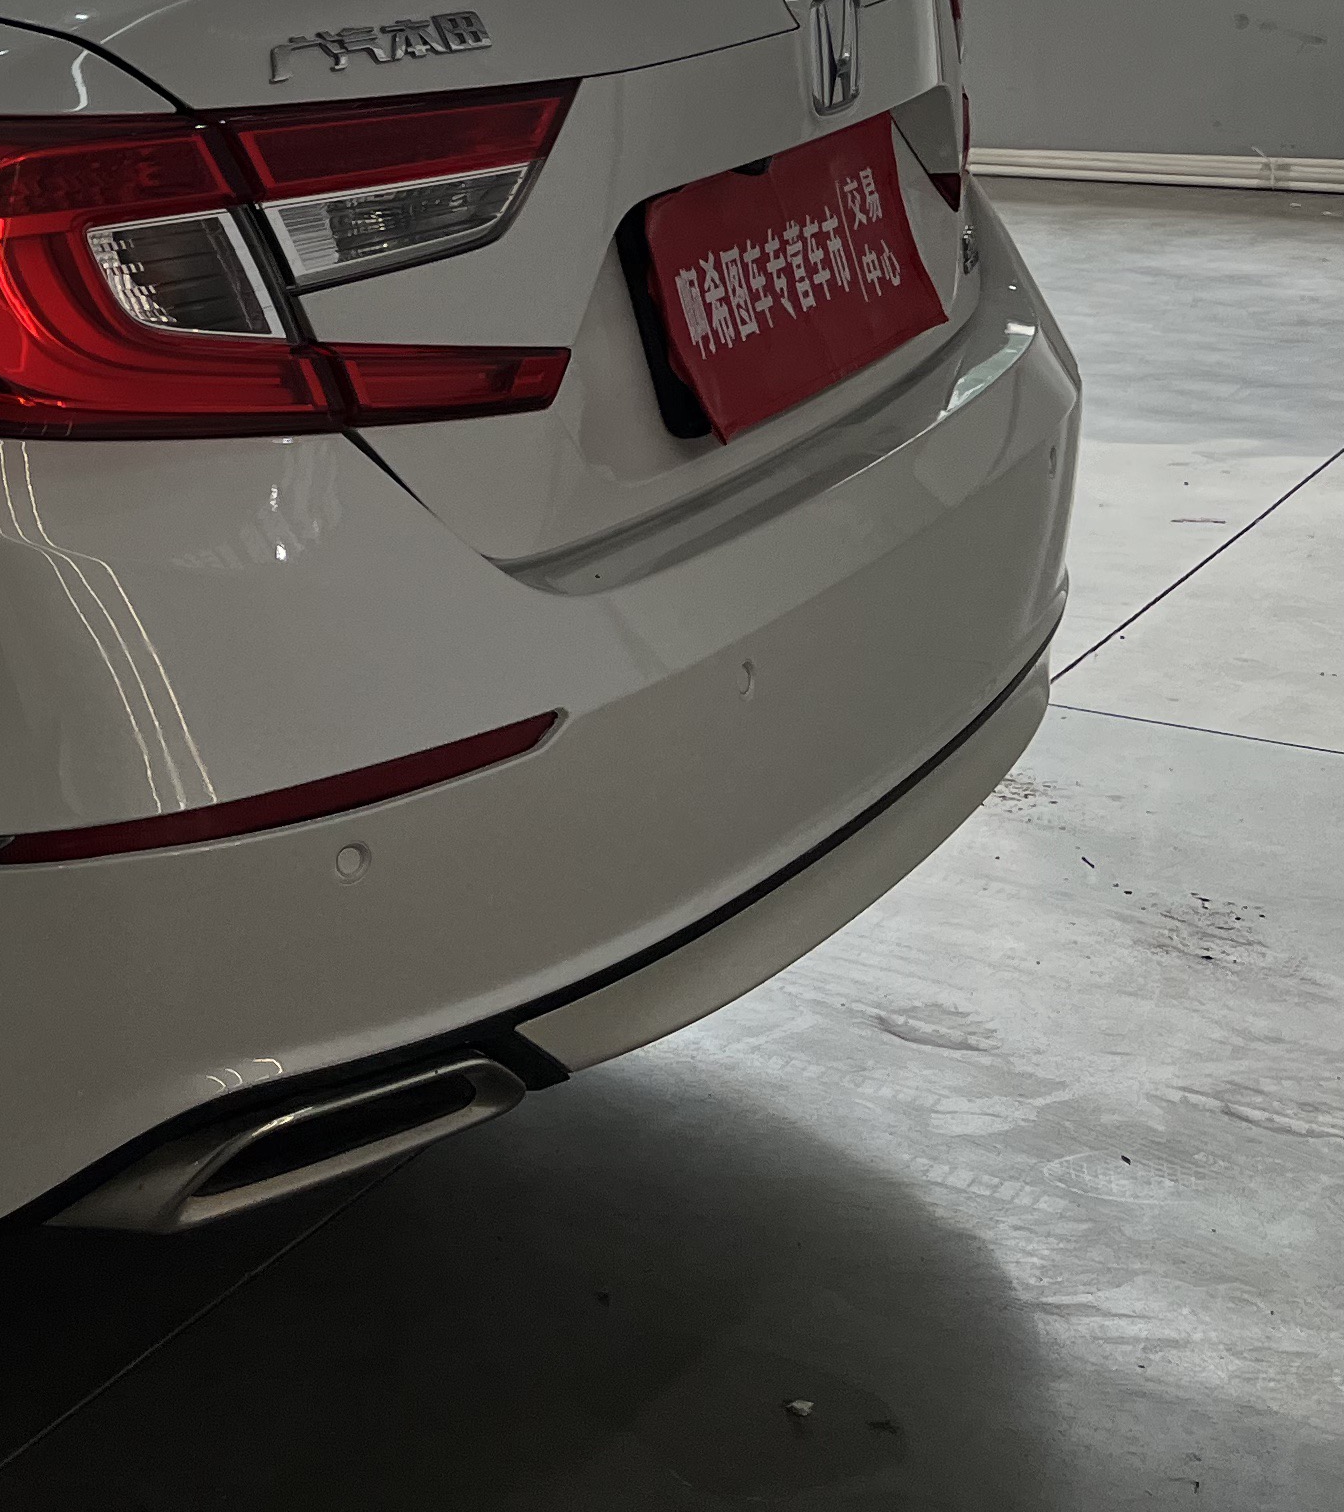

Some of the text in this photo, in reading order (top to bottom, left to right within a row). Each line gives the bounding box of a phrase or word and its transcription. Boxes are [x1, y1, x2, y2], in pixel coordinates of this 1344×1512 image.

[268, 10, 493, 85] 广汽本田
[843, 167, 884, 231] 交易
[861, 239, 902, 297] 中心
